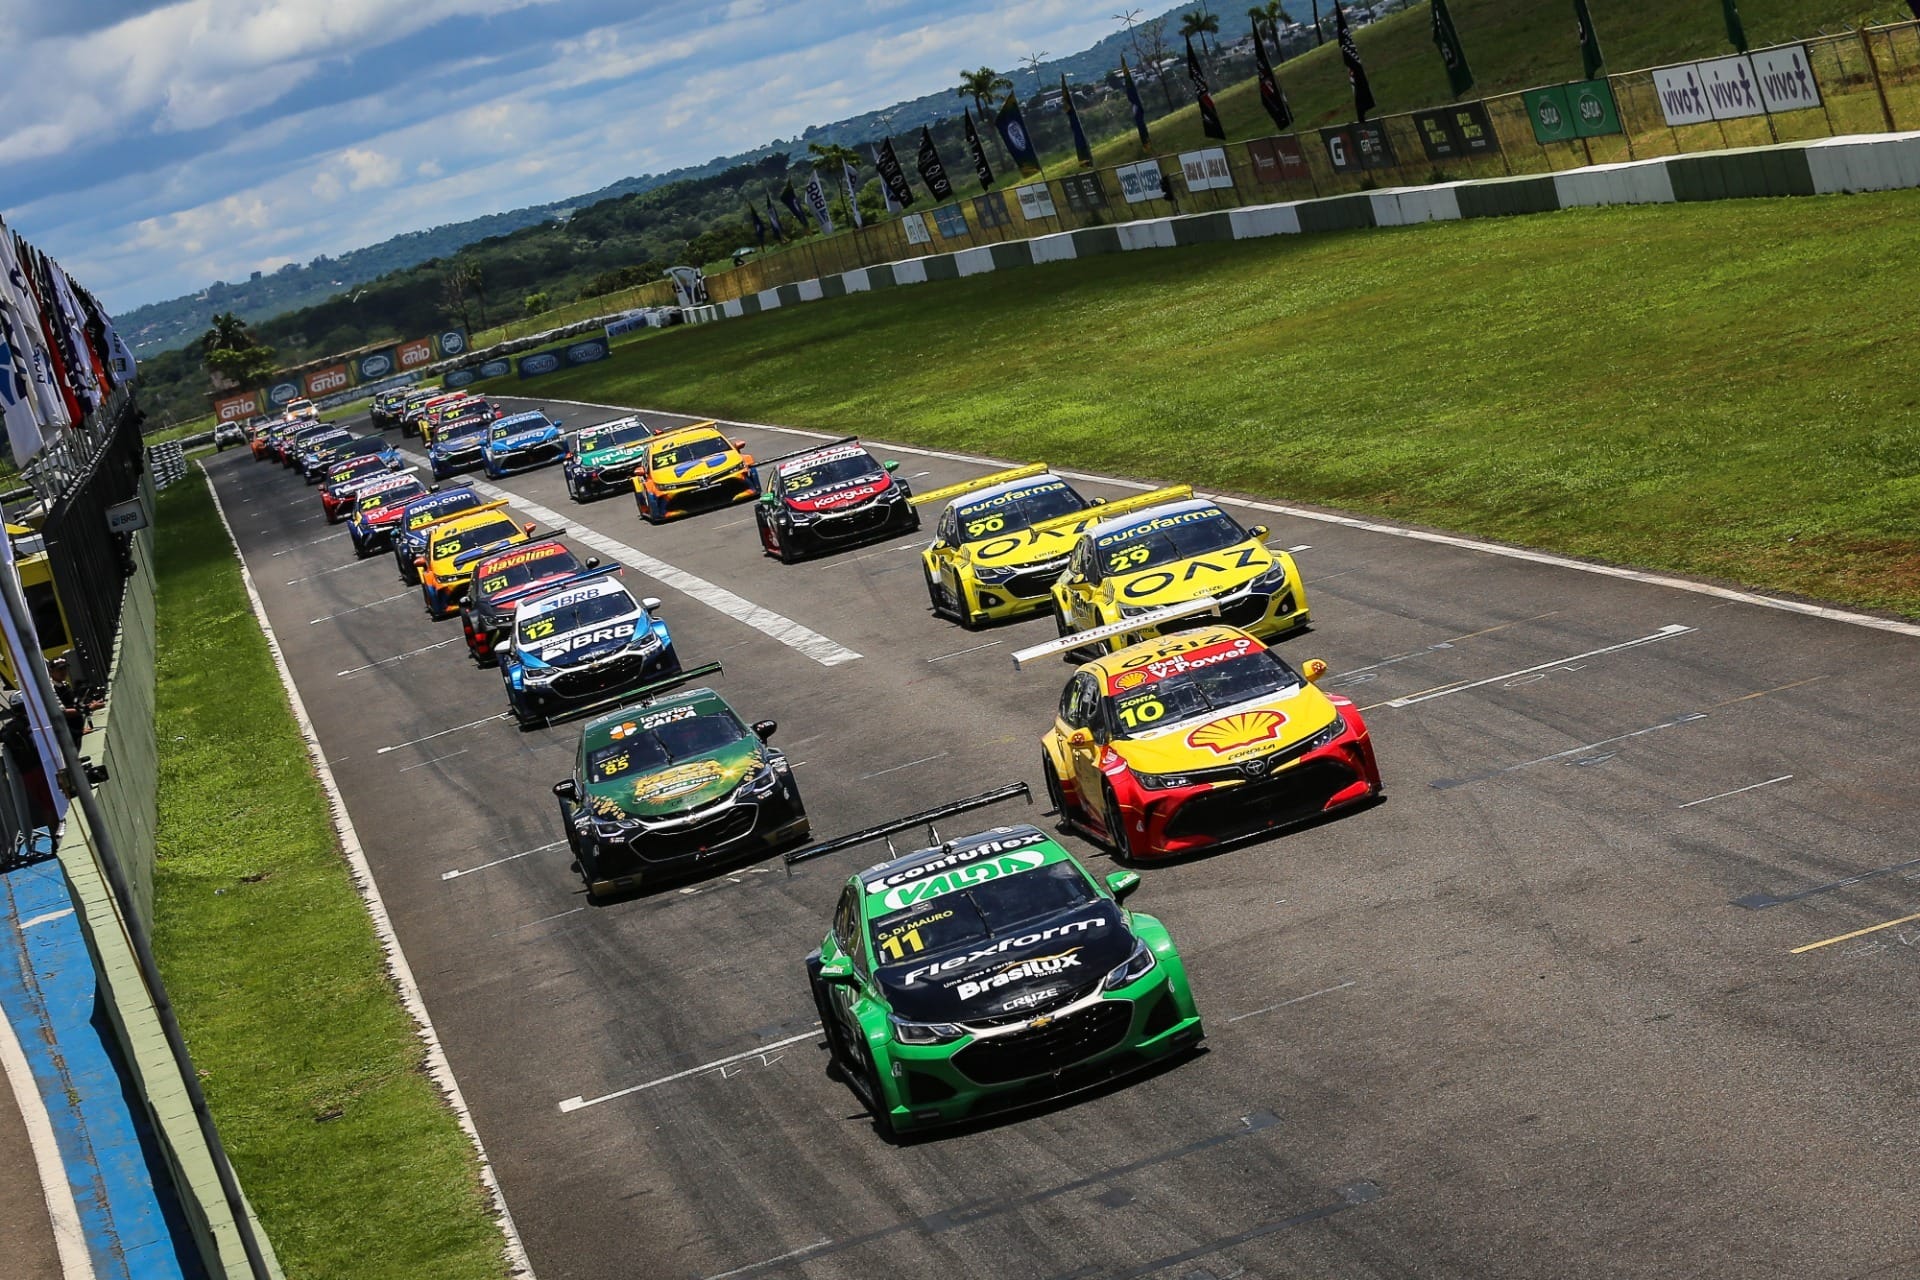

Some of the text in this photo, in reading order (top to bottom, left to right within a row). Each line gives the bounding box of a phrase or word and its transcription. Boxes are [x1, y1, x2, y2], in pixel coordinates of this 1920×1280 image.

[1709, 70, 1743, 109] vivo
[1763, 61, 1798, 102] vivo
[1662, 78, 1693, 116] vivo
[787, 476, 814, 491] 33
[960, 482, 1066, 515] eurofarma
[968, 518, 1004, 538] 90
[1099, 507, 1222, 547] eurofarma
[487, 548, 555, 575] Havoline
[1110, 549, 1150, 573] 29
[484, 578, 509, 593] 121
[561, 588, 600, 606] BRB
[526, 622, 555, 640] 12
[572, 624, 635, 649] BRB
[1147, 655, 1184, 672] Shell
[1151, 647, 1248, 679] V-Power
[1120, 693, 1157, 709] ZONTA
[640, 705, 695, 724] loterias
[643, 711, 697, 730] CAIXA
[1118, 701, 1165, 729] 10
[604, 760, 629, 776] 85
[897, 857, 1036, 905] VALDA
[907, 910, 954, 931] MAURO
[881, 928, 925, 960] 11
[904, 917, 1106, 986] Flexform
[956, 953, 1082, 1001] Brasilux
[1033, 968, 1064, 978] TINTAS
[1003, 987, 1058, 1011] CRUZE
